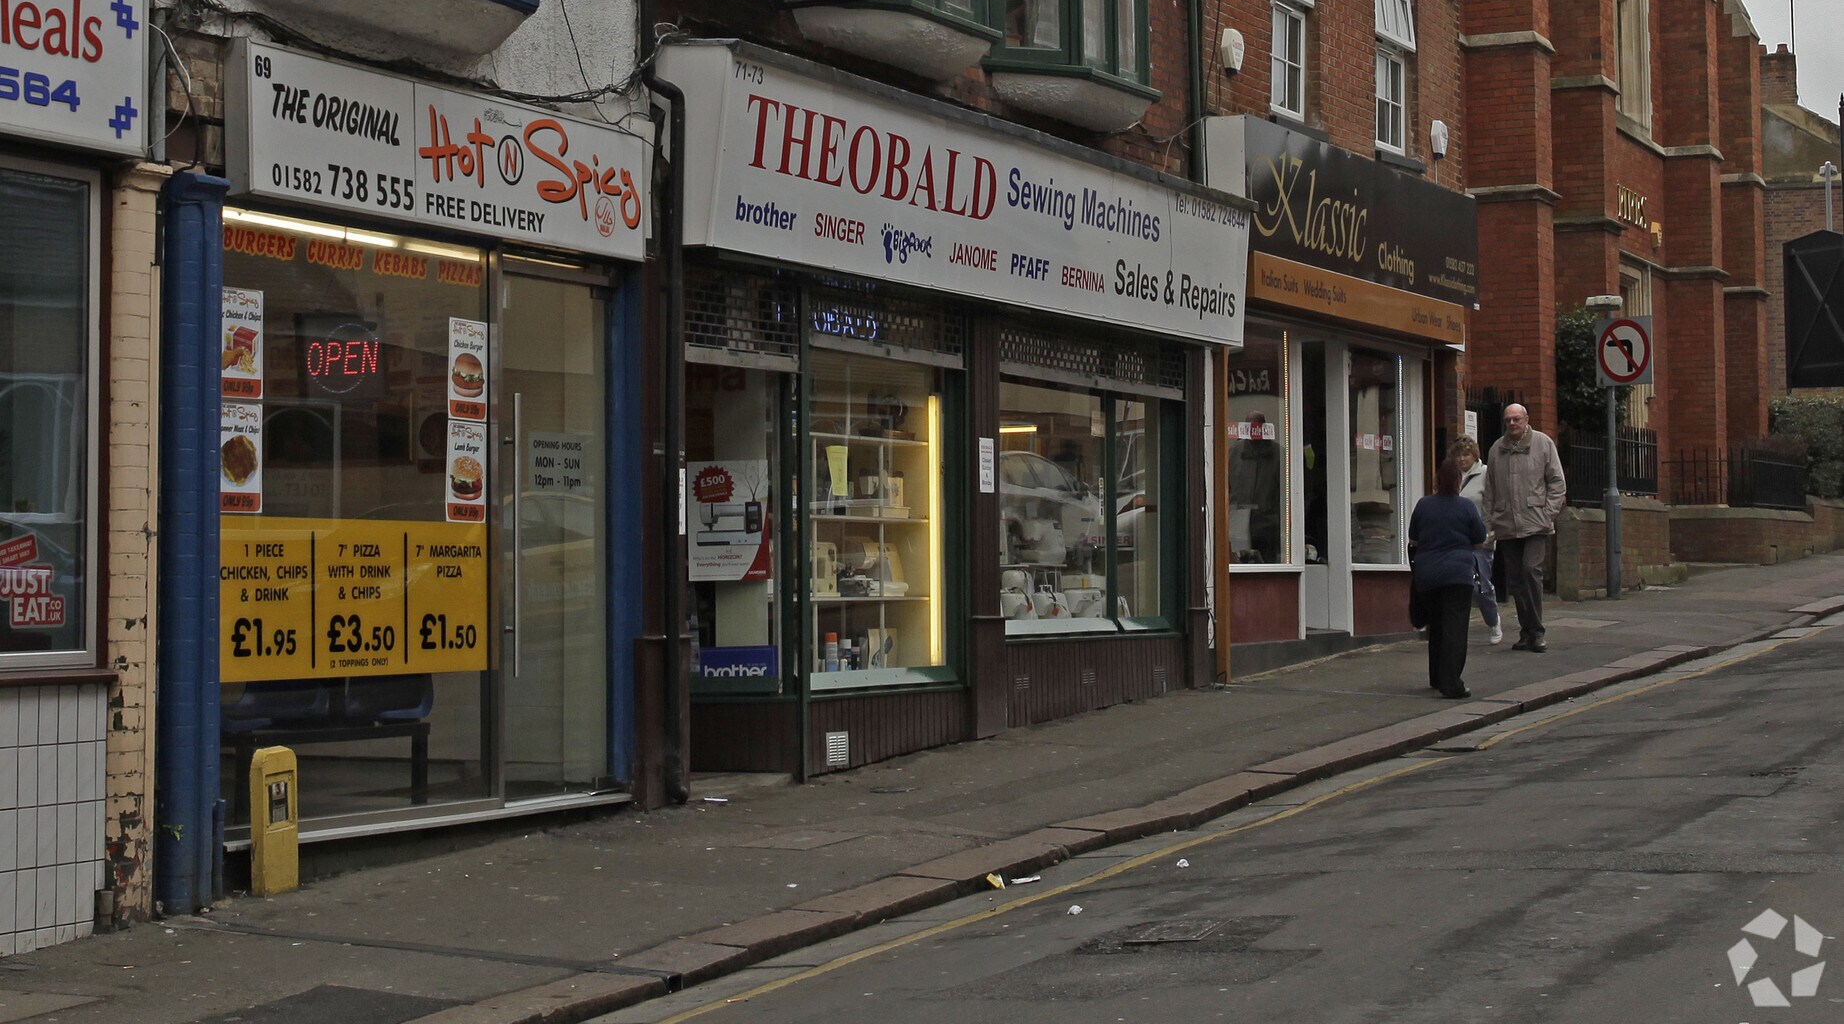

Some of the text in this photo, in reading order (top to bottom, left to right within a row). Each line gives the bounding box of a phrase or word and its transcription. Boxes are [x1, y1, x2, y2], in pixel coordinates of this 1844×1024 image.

[254, 55, 272, 79] 69
[735, 61, 764, 85] 71-73
[272, 83, 400, 147] THE ORIGINAL
[418, 104, 642, 231] Hot N Spicy
[747, 93, 997, 221] THEOBALD
[272, 163, 415, 211] 01582 738 555
[426, 192, 546, 233] FREE DELIVERY
[735, 195, 797, 231] brother
[1007, 167, 1161, 243] Sewing Machines
[1175, 193, 1189, 215] Tel:
[1192, 198, 1216, 222] 01582
[814, 212, 866, 246] SINGER
[222, 226, 483, 287] BURGERS CURRYS KEBABS PIZZAS
[949, 242, 998, 272] JANOME
[1010, 253, 1050, 282] PFAFF
[1378, 241, 1415, 285] Clothing
[1061, 265, 1105, 294] BERNINA
[1114, 258, 1236, 320] Sales & Repairs
[1261, 268, 1282, 290] Italian
[1304, 278, 1332, 306] Wedding
[306, 340, 380, 376] OPEN
[533, 439, 583, 451] OPENING HOURS
[535, 456, 555, 468] MON
[564, 457, 580, 469] SUN
[534, 474, 554, 489] 12pm
[563, 475, 581, 490] 11pm
[700, 474, 726, 488] £500
[244, 543, 284, 558] 1 PIECE
[353, 544, 381, 557] PIZZA
[429, 544, 482, 558] MARGARITA
[1, 569, 51, 595] JUST
[220, 565, 308, 582] CHICKEN, CHIPS
[328, 565, 391, 578] WITH DRINK
[436, 565, 462, 578] PIZZA
[240, 587, 289, 602] & DRINK
[338, 586, 381, 600] & CHIPS
[13, 597, 50, 622] EAT
[231, 618, 297, 657] £1.95
[327, 614, 395, 653] £3.50
[419, 613, 477, 650] £1.50
[339, 658, 369, 668] TOPPINGS
[704, 664, 767, 677] brother
